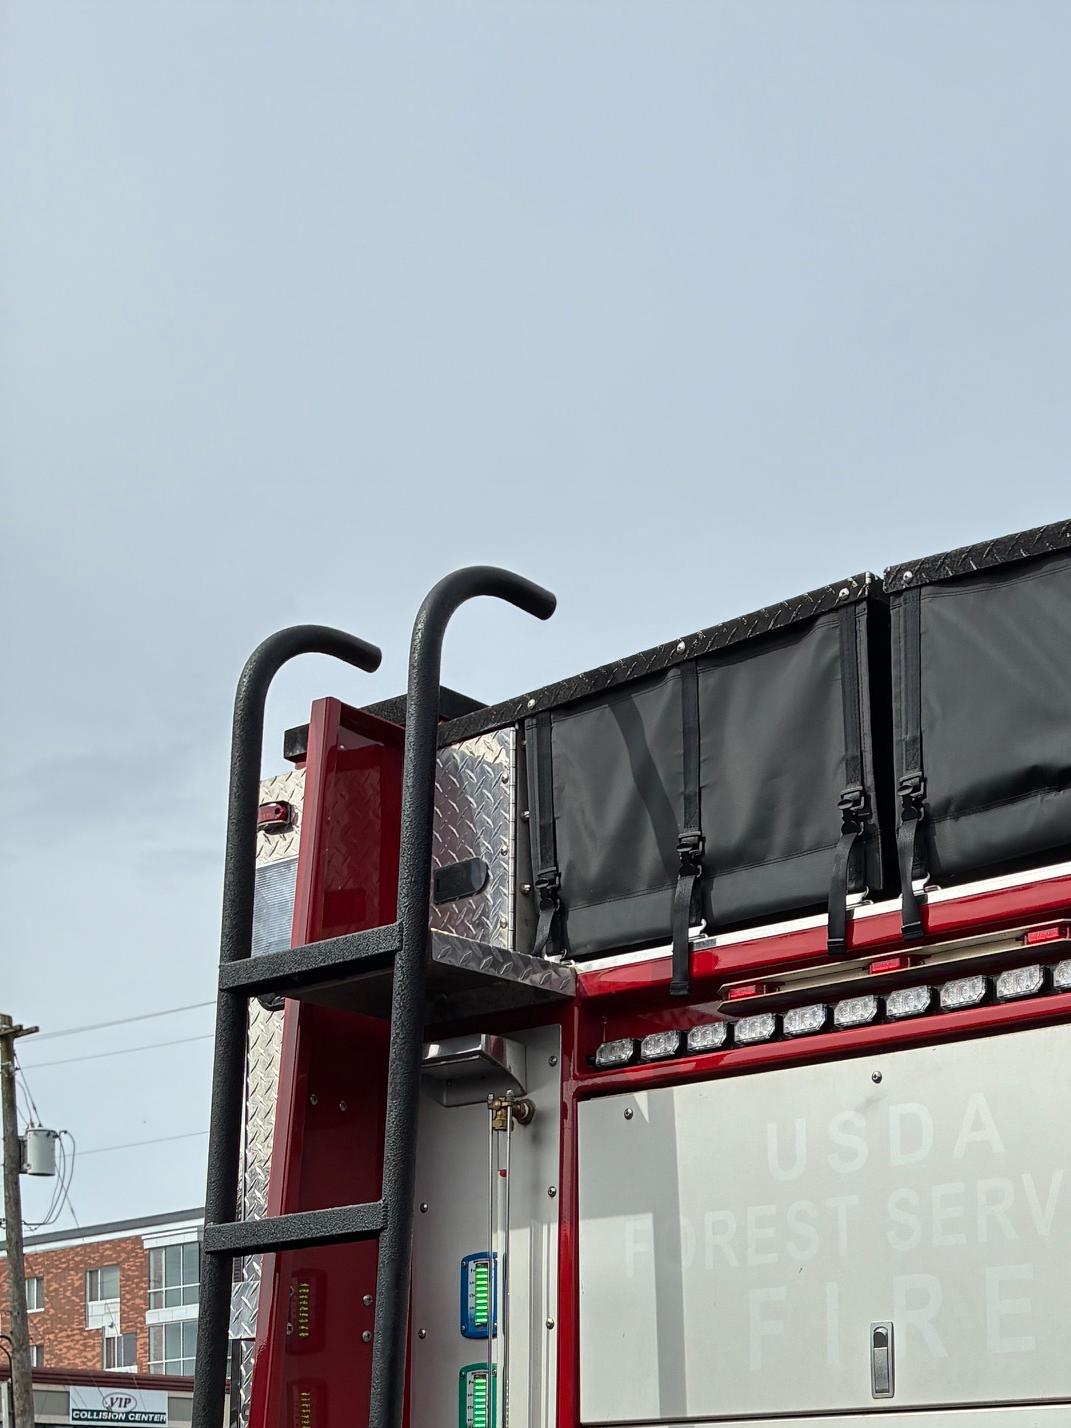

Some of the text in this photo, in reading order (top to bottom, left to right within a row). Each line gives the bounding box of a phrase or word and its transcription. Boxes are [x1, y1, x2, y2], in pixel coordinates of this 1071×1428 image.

[766, 1091, 1006, 1183] USDA
[748, 1263, 1040, 1371] FIRE
[72, 1411, 167, 1422] COLLISION CENTER
[108, 1397, 132, 1408] VIP
